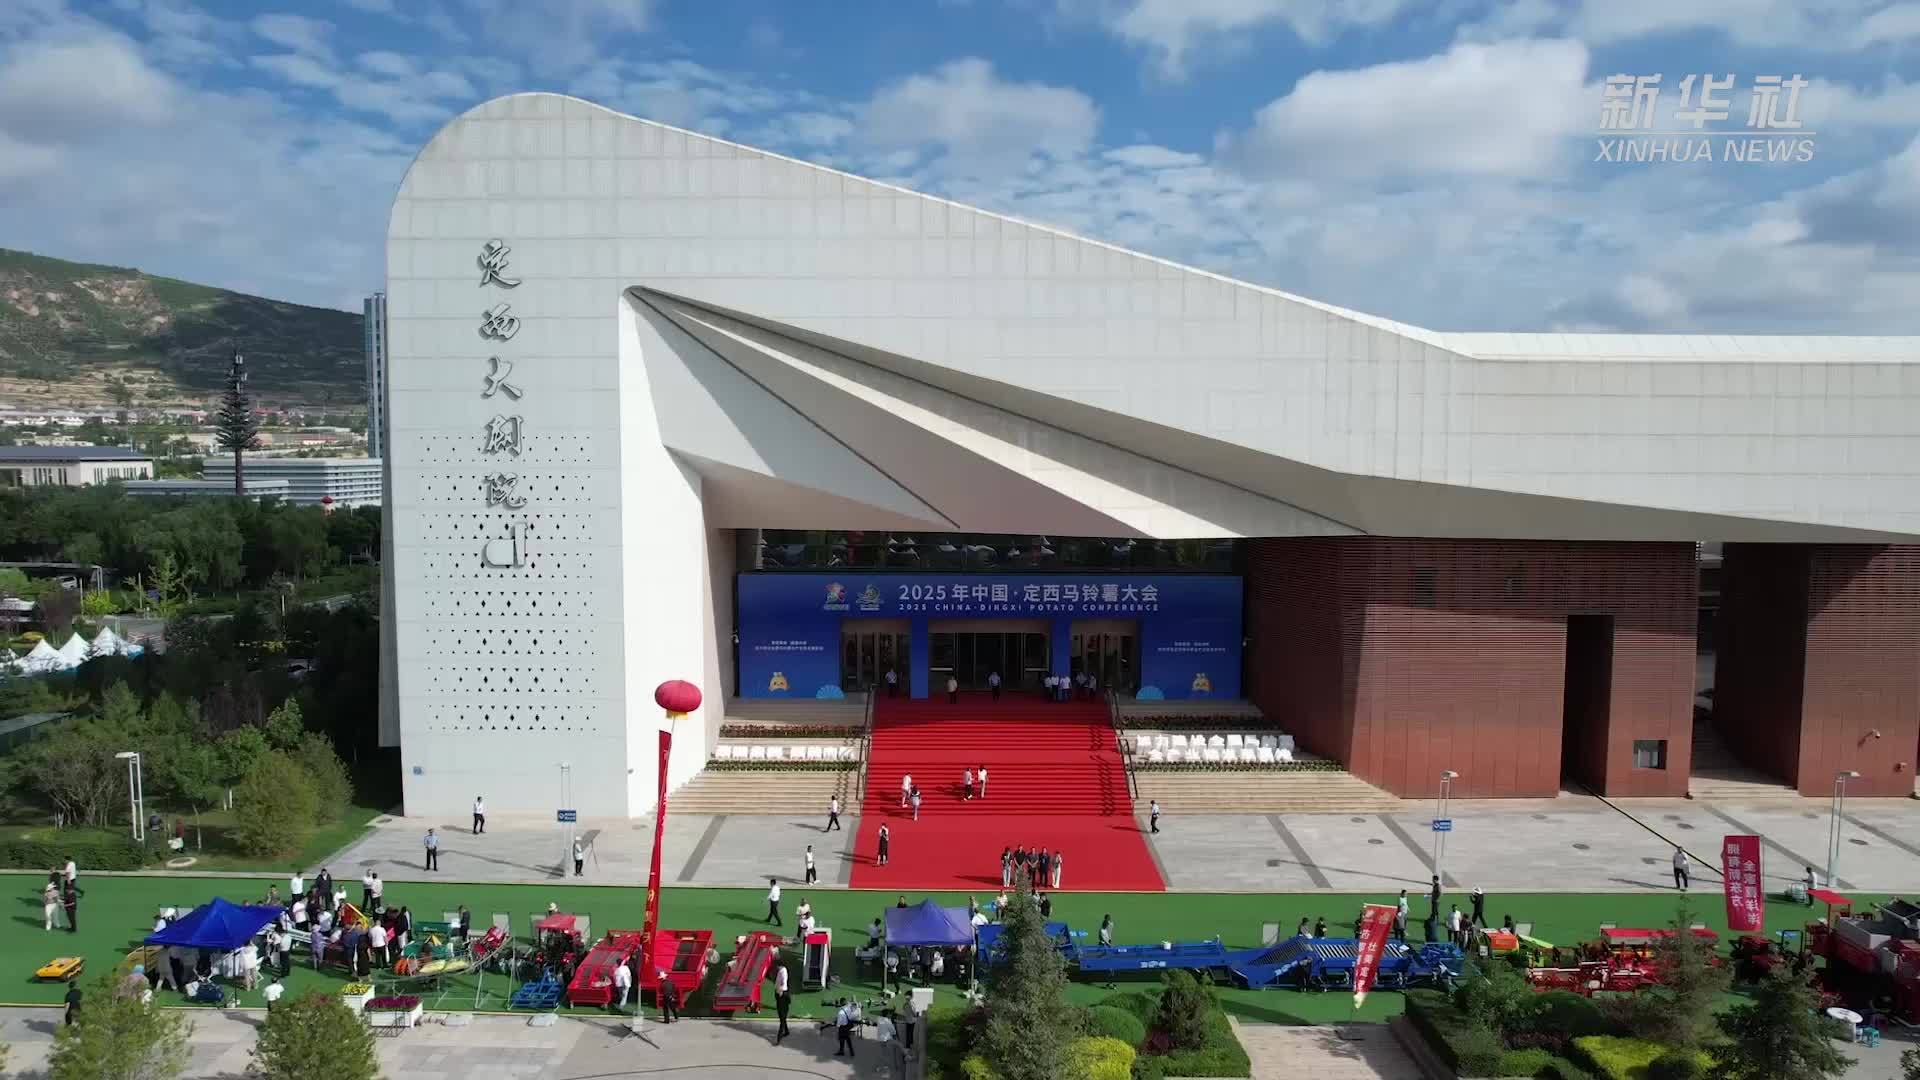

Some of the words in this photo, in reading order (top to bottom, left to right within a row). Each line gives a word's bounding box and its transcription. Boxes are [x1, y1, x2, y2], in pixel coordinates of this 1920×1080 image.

[899, 603, 927, 611] 2025
[1029, 603, 1075, 611] POTATO
[1082, 603, 1159, 611] CONFERENCE
